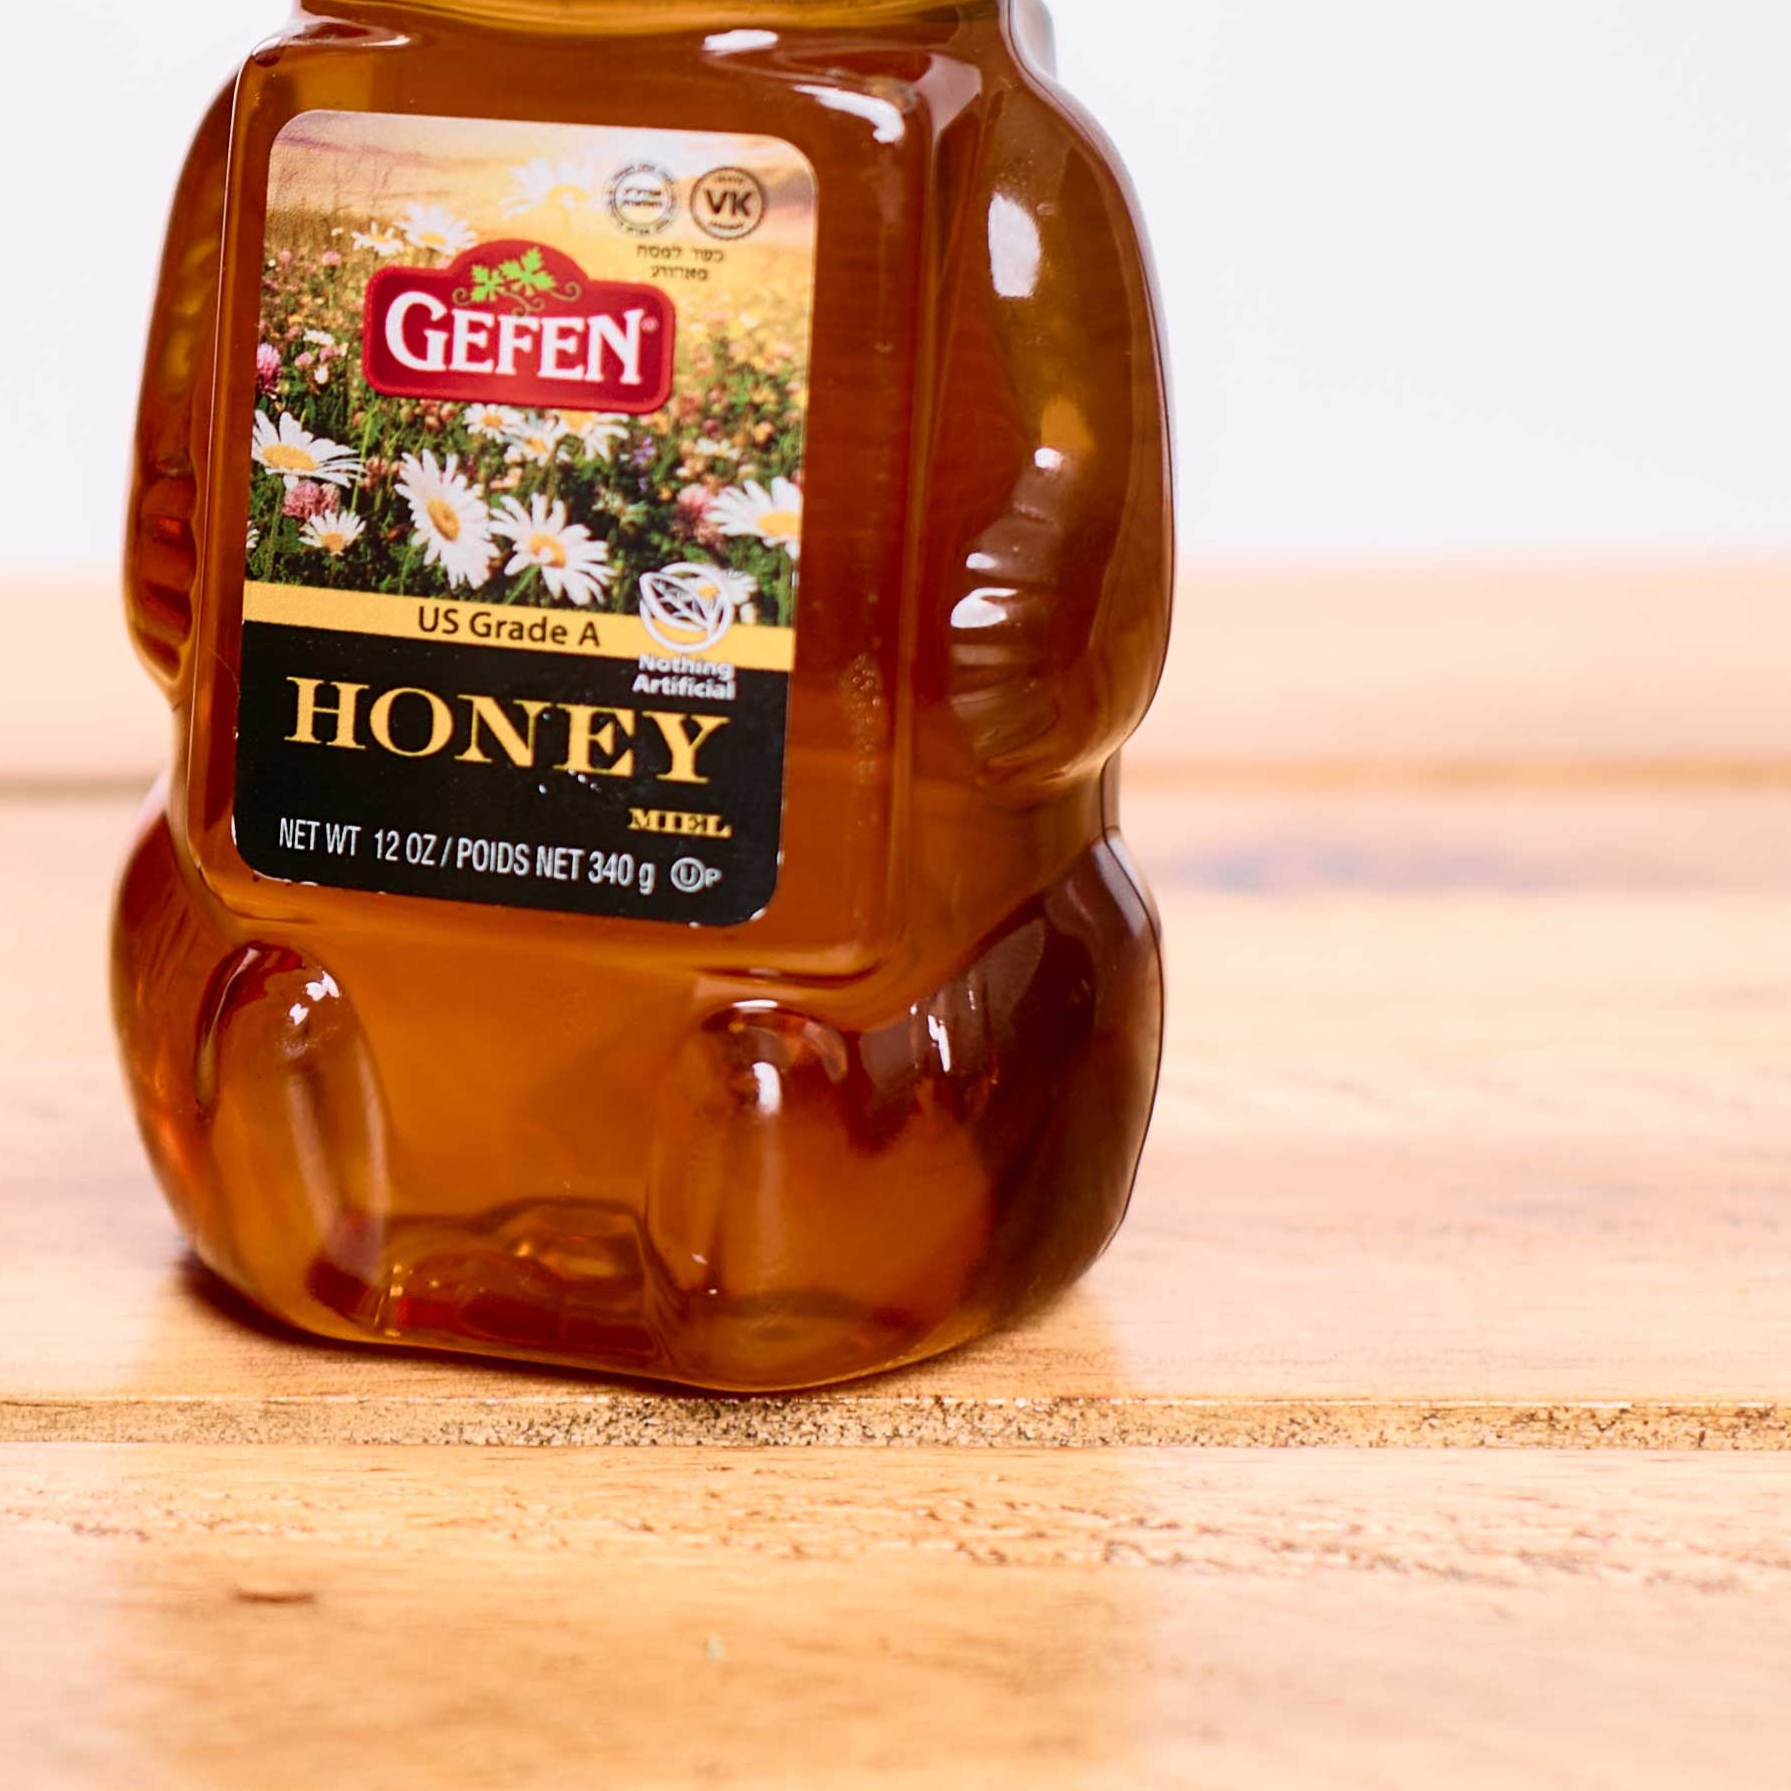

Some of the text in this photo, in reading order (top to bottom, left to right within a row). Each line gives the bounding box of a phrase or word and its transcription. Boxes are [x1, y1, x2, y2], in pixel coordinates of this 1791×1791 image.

[704, 188, 752, 217] VK
[384, 290, 645, 386] GEFEN
[417, 605, 601, 648] US Grade A
[639, 653, 735, 681] Nothing
[632, 674, 736, 701] Artificial
[284, 676, 731, 784] HONEY
[628, 808, 732, 838] MIEL
[279, 817, 320, 851] NET
[325, 822, 362, 856] WT
[374, 829, 400, 861] 12
[405, 832, 437, 866] OZ
[456, 837, 530, 876] POIDS
[535, 845, 585, 880] NET
[588, 850, 634, 887] 340
[638, 862, 656, 895] g
